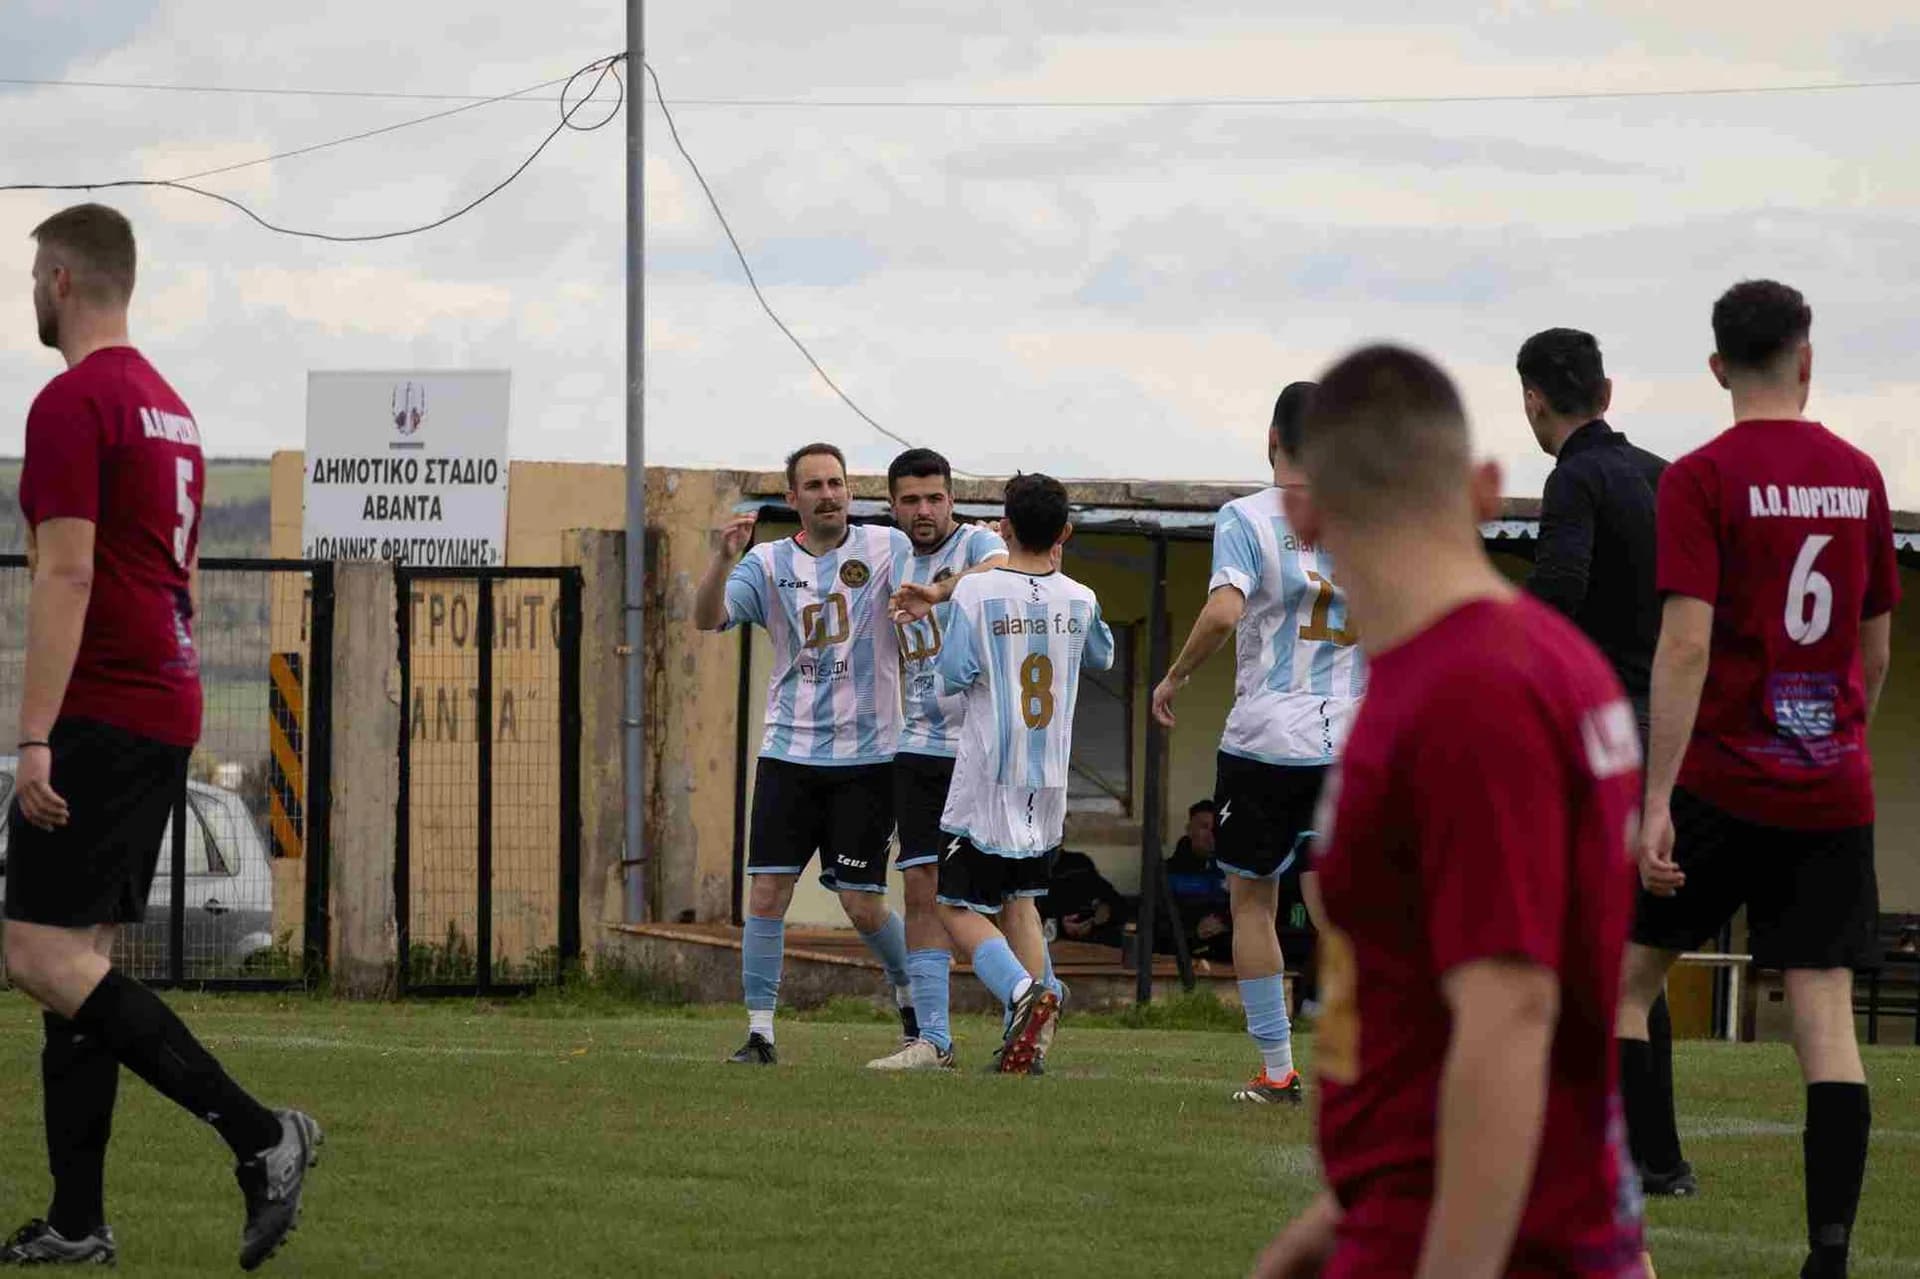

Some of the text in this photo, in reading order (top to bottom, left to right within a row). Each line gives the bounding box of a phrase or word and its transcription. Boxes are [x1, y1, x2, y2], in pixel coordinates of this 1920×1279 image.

[312, 458, 498, 484] ΔΗΜΟΤΙΚΟ ΣΤΑΔΙΟ
[174, 457, 195, 568] 5
[362, 495, 442, 520] ΑΒΑΝΤΑ
[778, 578, 809, 589] Zeus
[1784, 534, 1833, 645] 6
[993, 613, 1082, 636] alana f.c.
[1020, 653, 1054, 730] 8
[837, 854, 868, 869] Zeus
